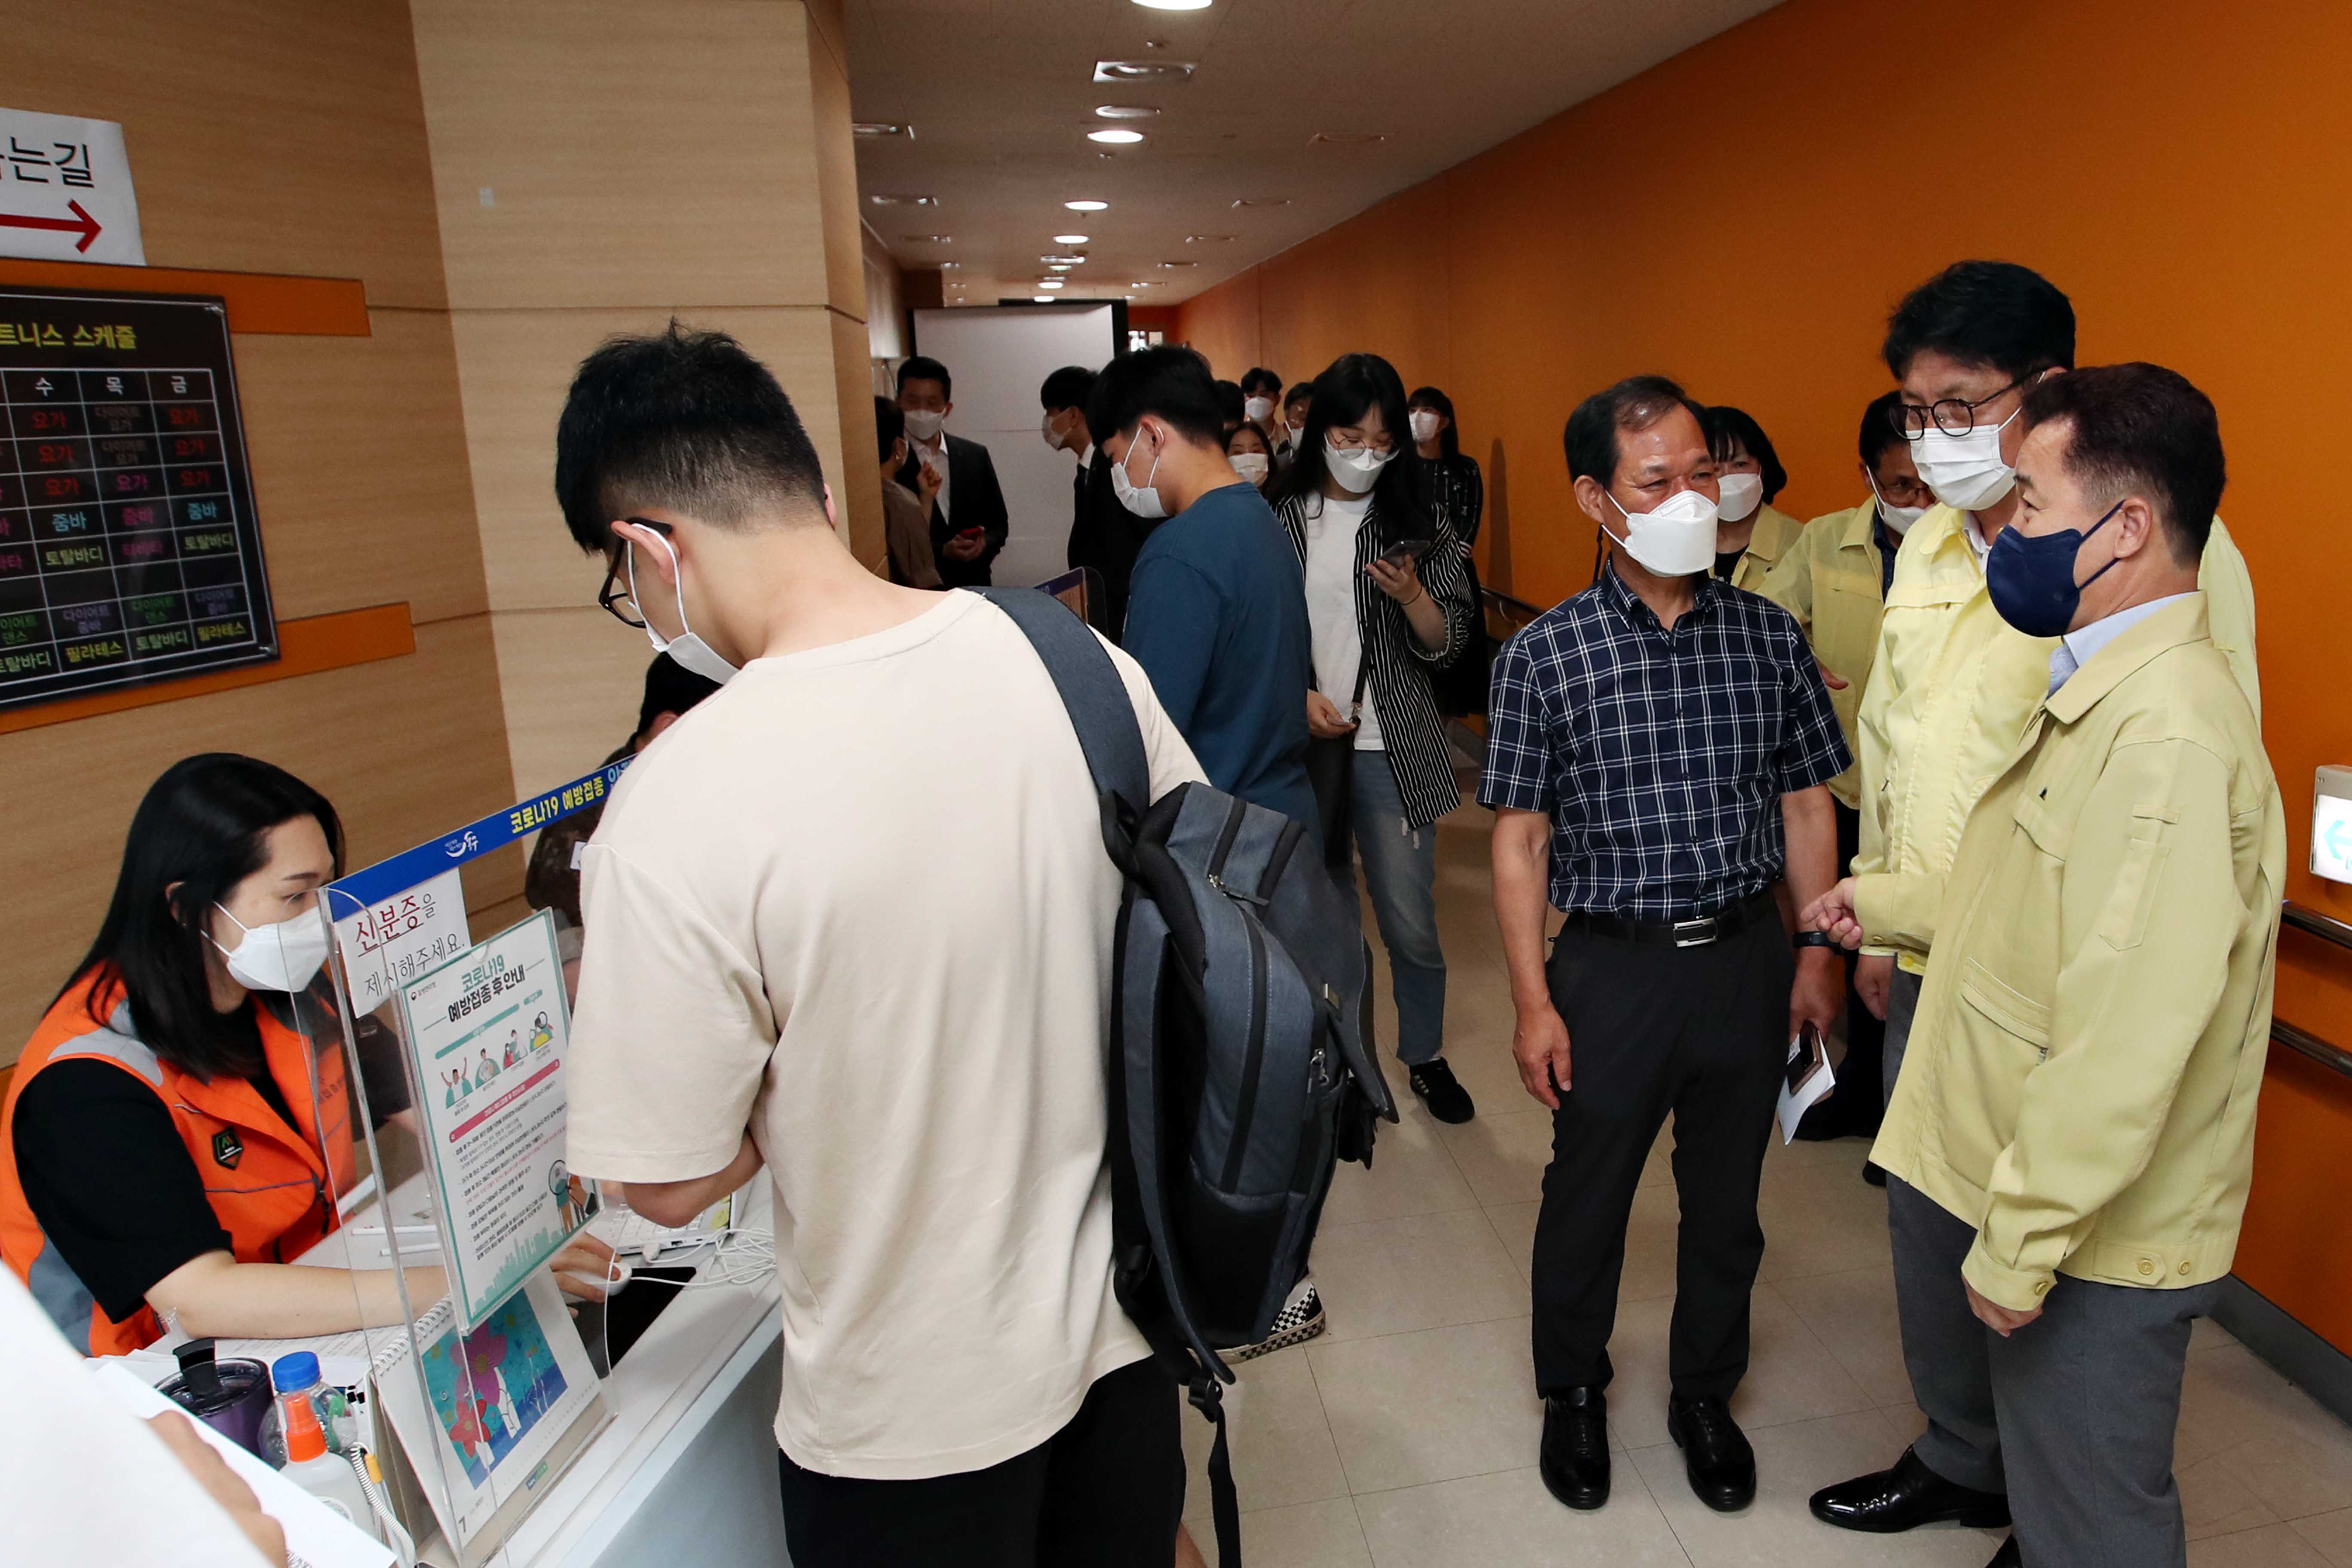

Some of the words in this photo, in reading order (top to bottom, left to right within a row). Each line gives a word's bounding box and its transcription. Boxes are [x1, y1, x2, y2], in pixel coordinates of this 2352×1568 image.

[0, 136, 95, 188] 는길
[34, 376, 54, 397] 수
[106, 376, 124, 396] 목
[171, 375, 188, 395] 금
[32, 411, 67, 429] 요가
[169, 407, 199, 426] 요가
[38, 444, 74, 464] 요가
[175, 438, 206, 456] 요가
[45, 477, 79, 496] 요가
[116, 473, 148, 491] 요가
[181, 470, 210, 487] 요가
[187, 501, 218, 521] 줌바
[52, 511, 87, 533] 줌바
[184, 532, 235, 551] 토탈바디
[46, 545, 104, 567] 토탈바디
[135, 629, 190, 651] 토탈바디
[196, 622, 247, 643] 필라테스
[65, 640, 124, 664] 필라테스
[510, 796, 559, 834] 코로나19
[562, 775, 604, 811] 예방접종
[356, 893, 437, 952] 신분증을
[365, 933, 466, 997] 제시해주세요.
[461, 954, 505, 993] 코로나19
[447, 983, 492, 1023] 예방접종
[492, 977, 504, 996] 후
[503, 964, 526, 990] 안내
